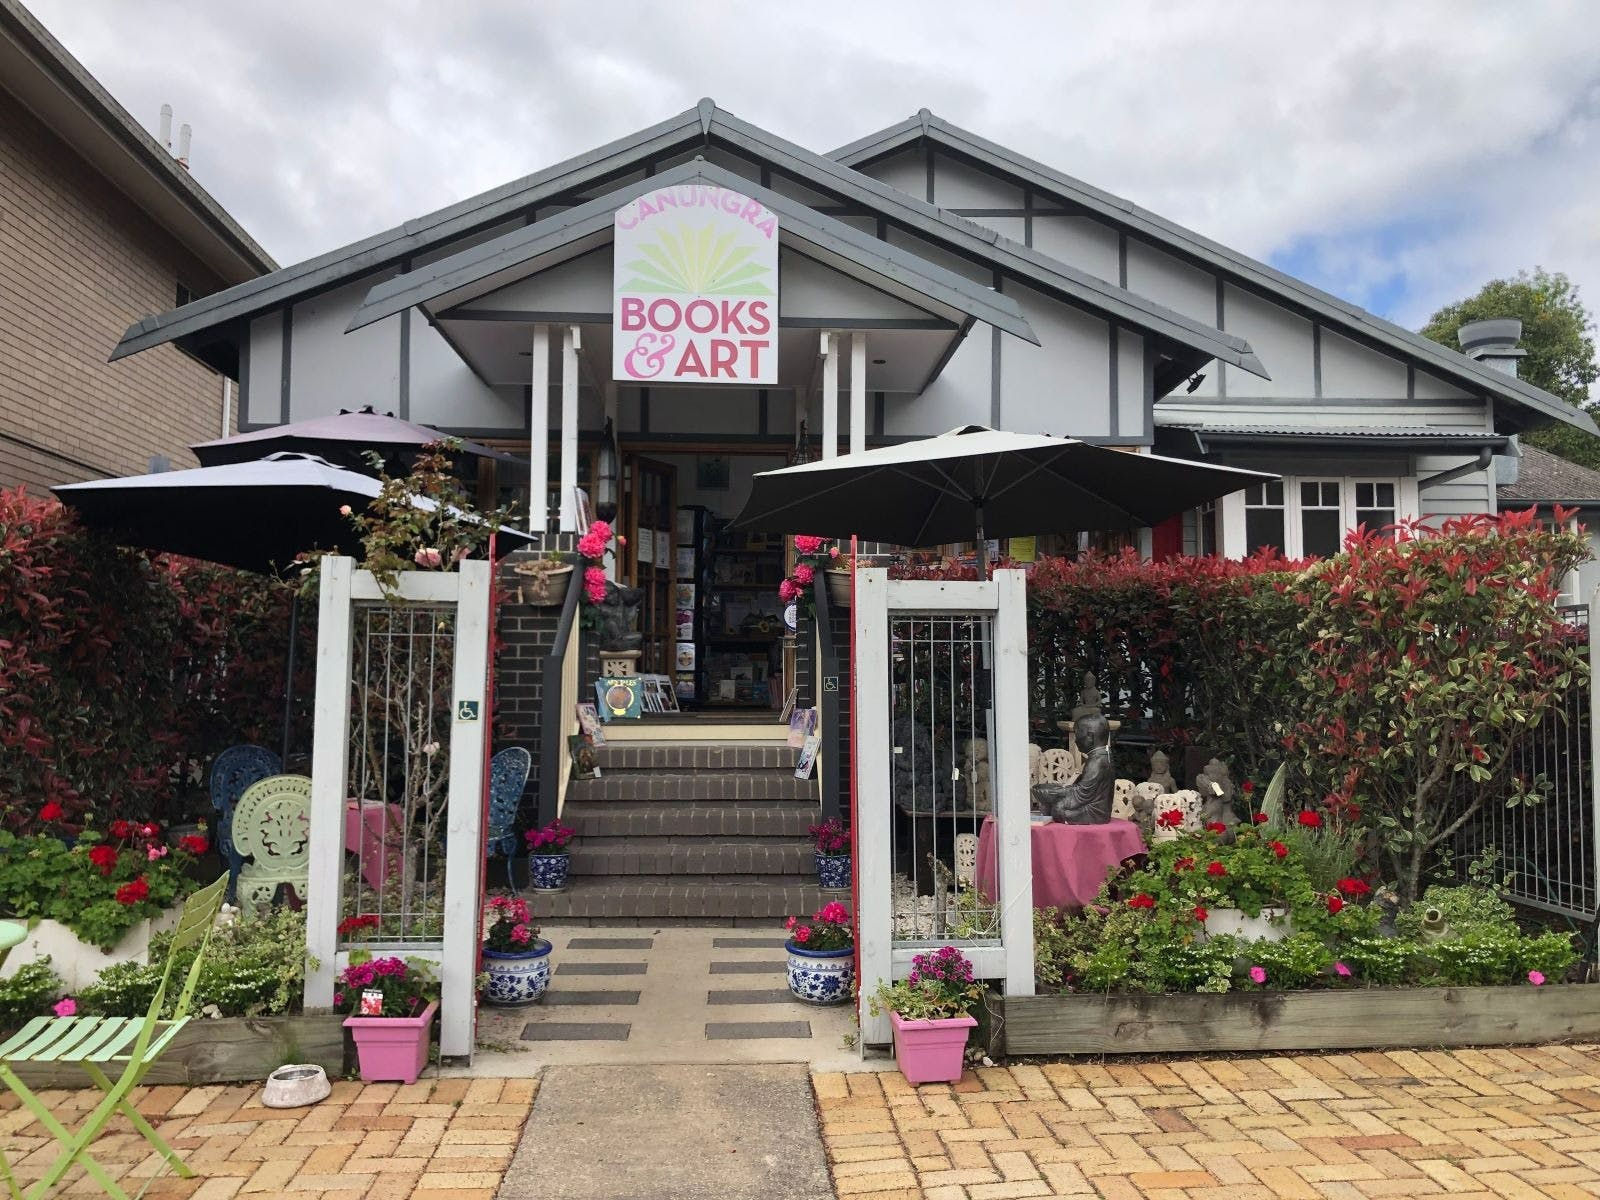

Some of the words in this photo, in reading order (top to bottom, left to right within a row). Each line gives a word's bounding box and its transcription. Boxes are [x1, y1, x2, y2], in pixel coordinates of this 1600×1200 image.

[618, 186, 777, 239] CANUNGRA
[622, 298, 770, 335] BOOKS
[624, 333, 675, 379] &
[674, 339, 769, 378] ART
